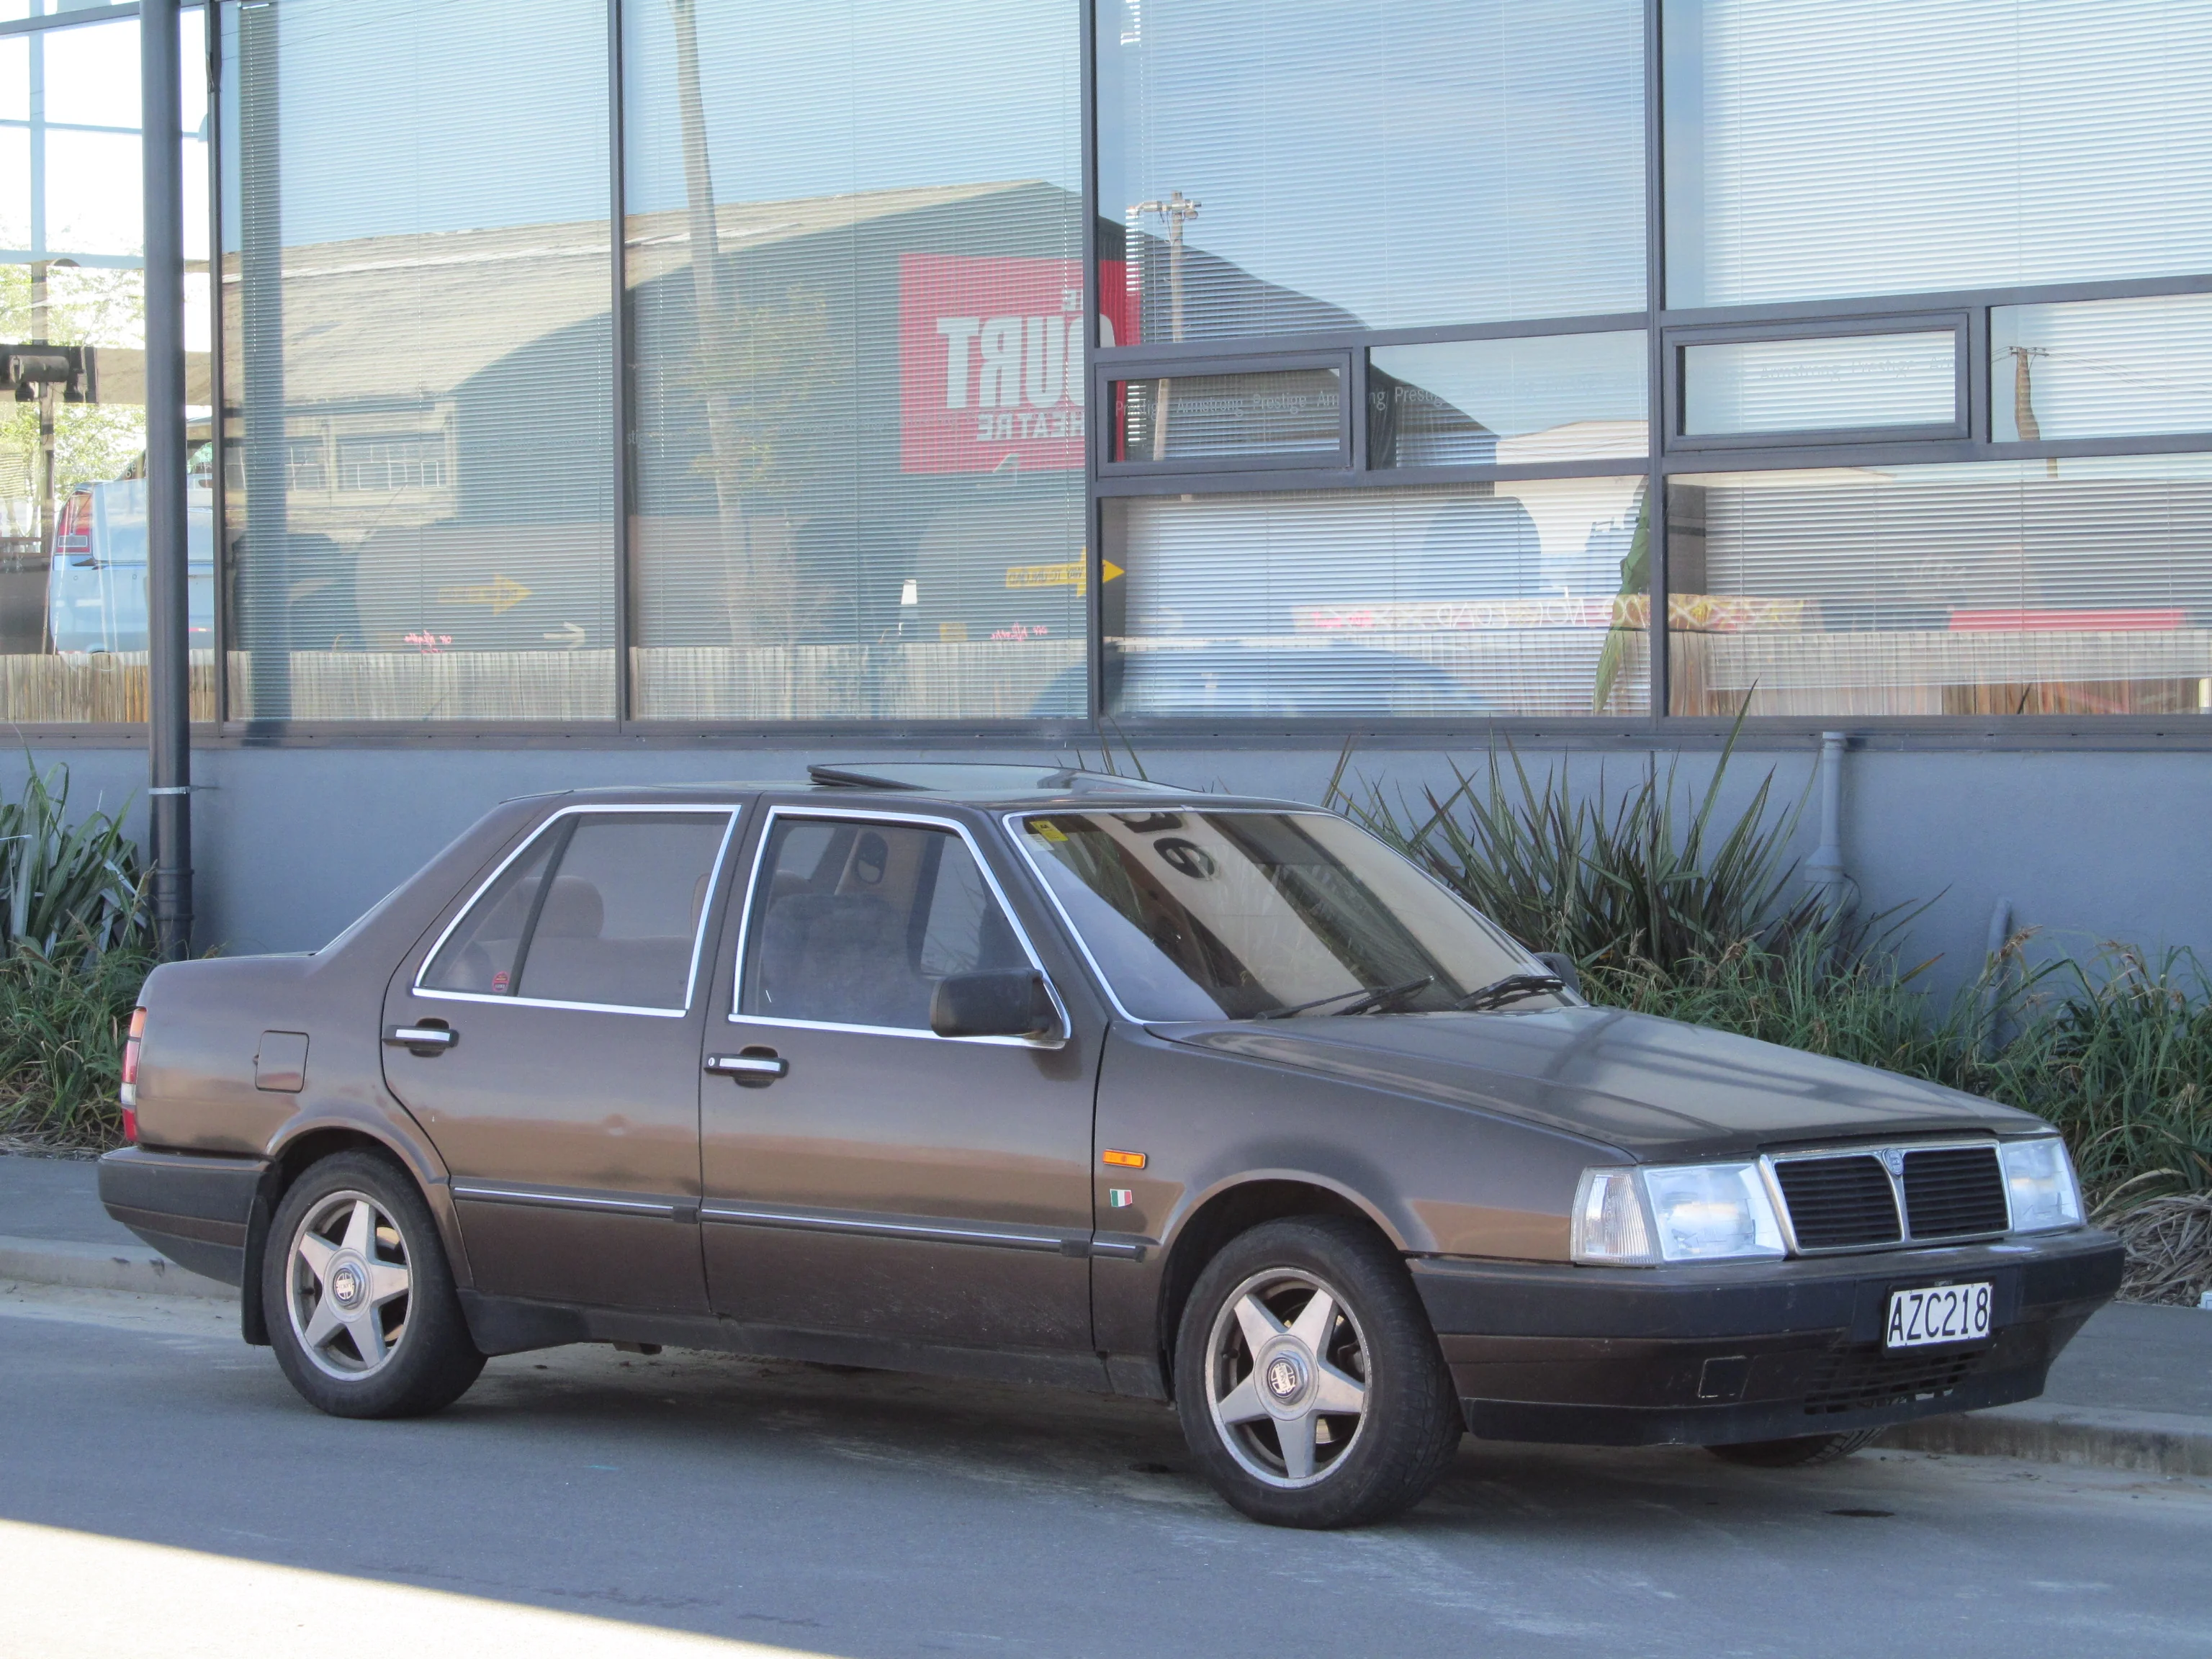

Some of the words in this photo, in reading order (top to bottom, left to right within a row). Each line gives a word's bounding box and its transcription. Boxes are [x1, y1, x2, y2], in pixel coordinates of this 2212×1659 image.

[1177, 397, 1244, 417] Armstrong
[1253, 392, 1307, 415] Prestige
[1888, 1287, 1988, 1342] AZC218
